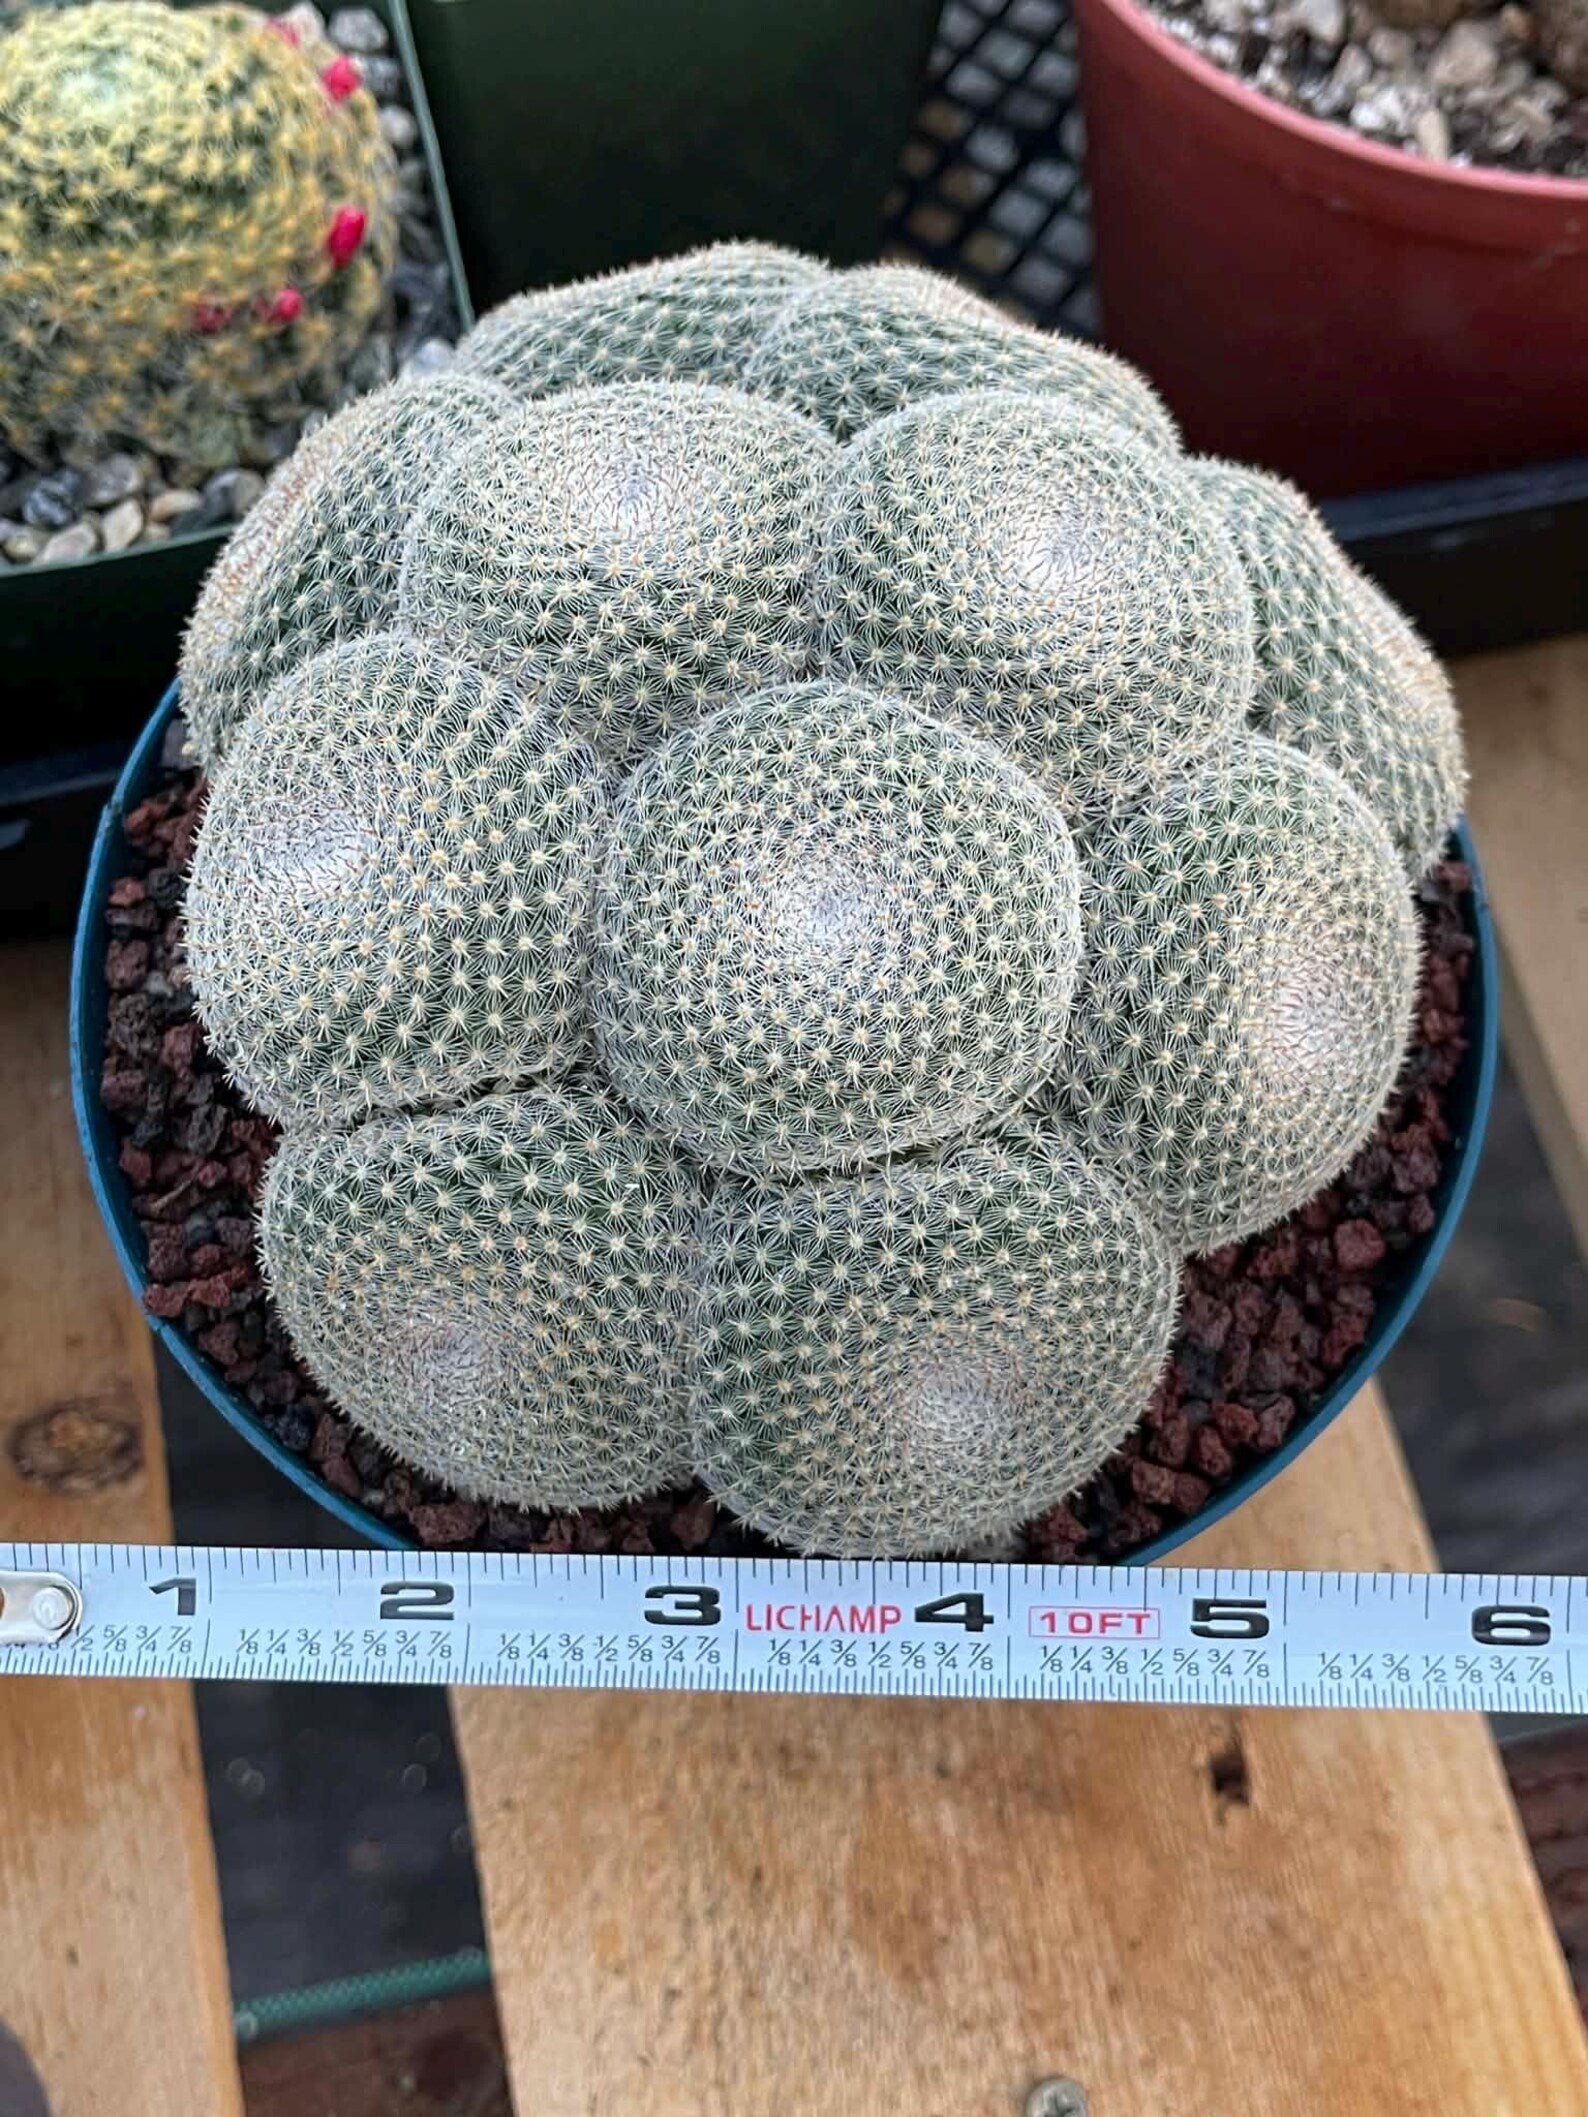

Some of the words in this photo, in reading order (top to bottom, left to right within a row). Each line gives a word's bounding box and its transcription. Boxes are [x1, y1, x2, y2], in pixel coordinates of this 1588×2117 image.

[150, 1578, 197, 1616] 1
[380, 1580, 455, 1621] 2
[644, 1585, 722, 1626] 3
[746, 1603, 902, 1633] LICHAMP
[915, 1593, 994, 1632] 4
[1040, 1611, 1151, 1635] 10FT
[1190, 1598, 1270, 1639] 5
[1471, 1605, 1551, 1646] 6
